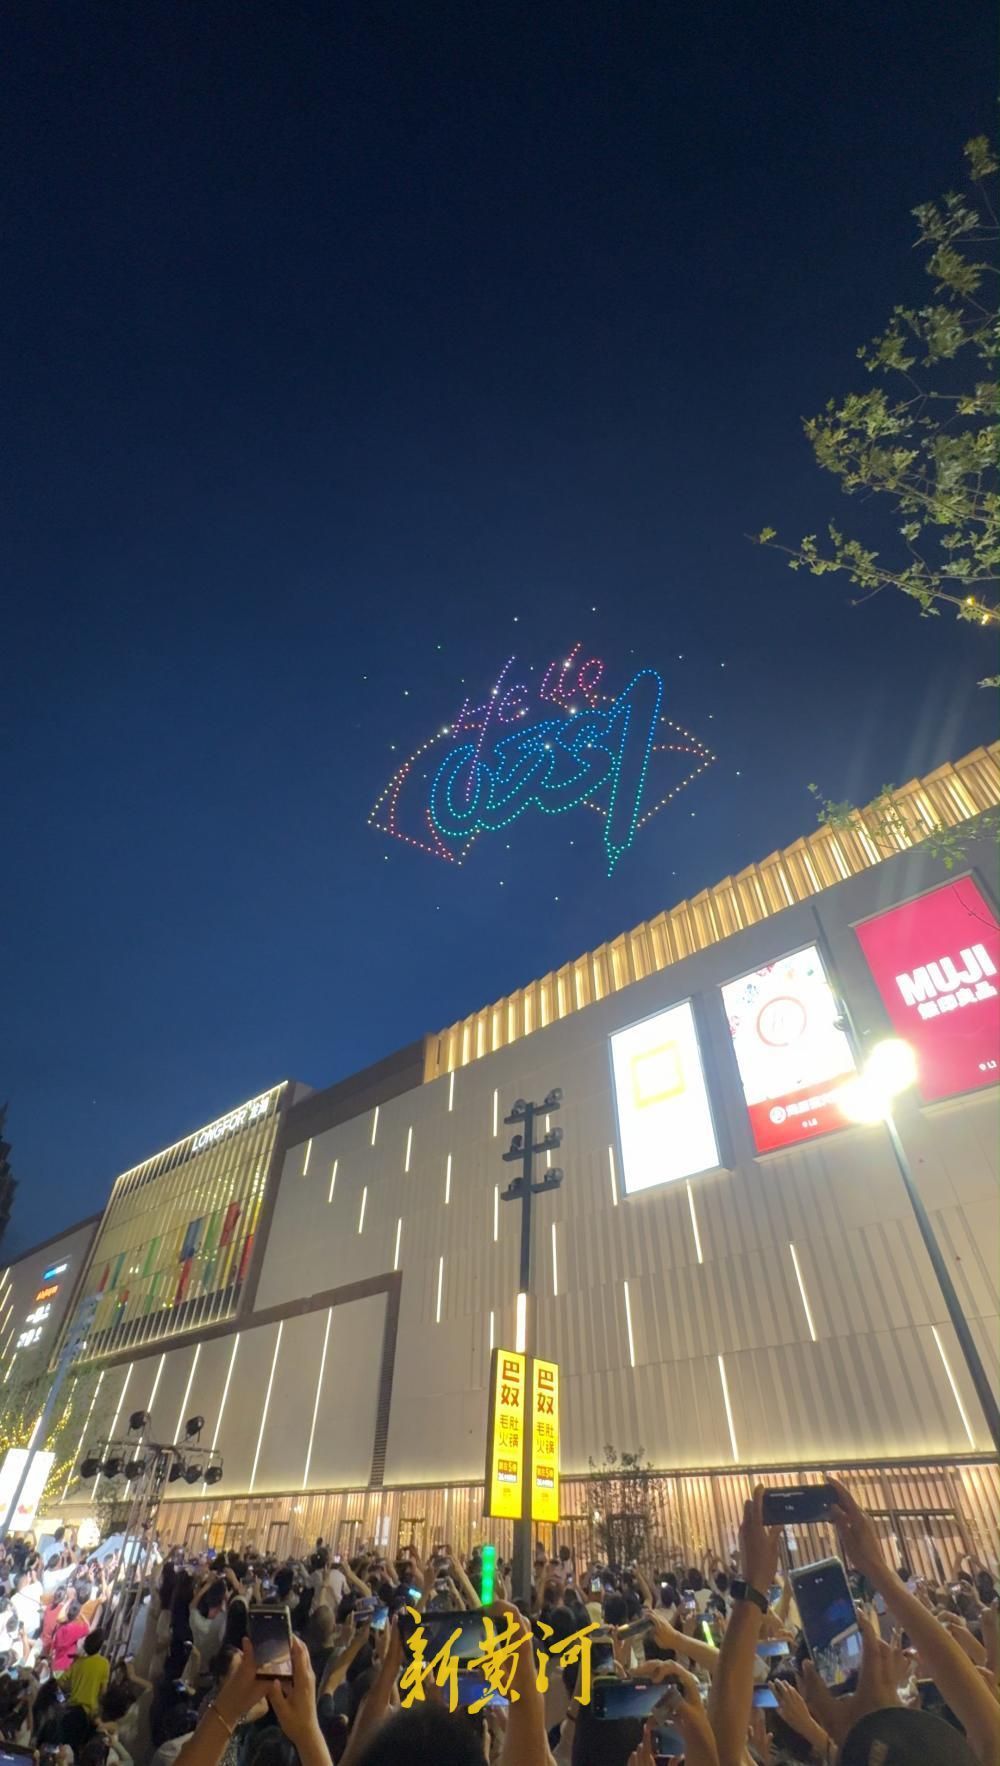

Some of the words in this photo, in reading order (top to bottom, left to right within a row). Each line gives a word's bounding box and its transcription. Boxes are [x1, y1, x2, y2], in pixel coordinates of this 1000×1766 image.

[895, 943, 998, 1006] MUJI
[191, 1109, 249, 1152] LONGFOR
[501, 1359, 520, 1408] 巴奴
[537, 1368, 554, 1415] 巴奴
[499, 1414, 519, 1431] 毛肚
[536, 1421, 554, 1438] 毛肚
[499, 1432, 519, 1448] 火锅
[536, 1440, 555, 1454] 火锅
